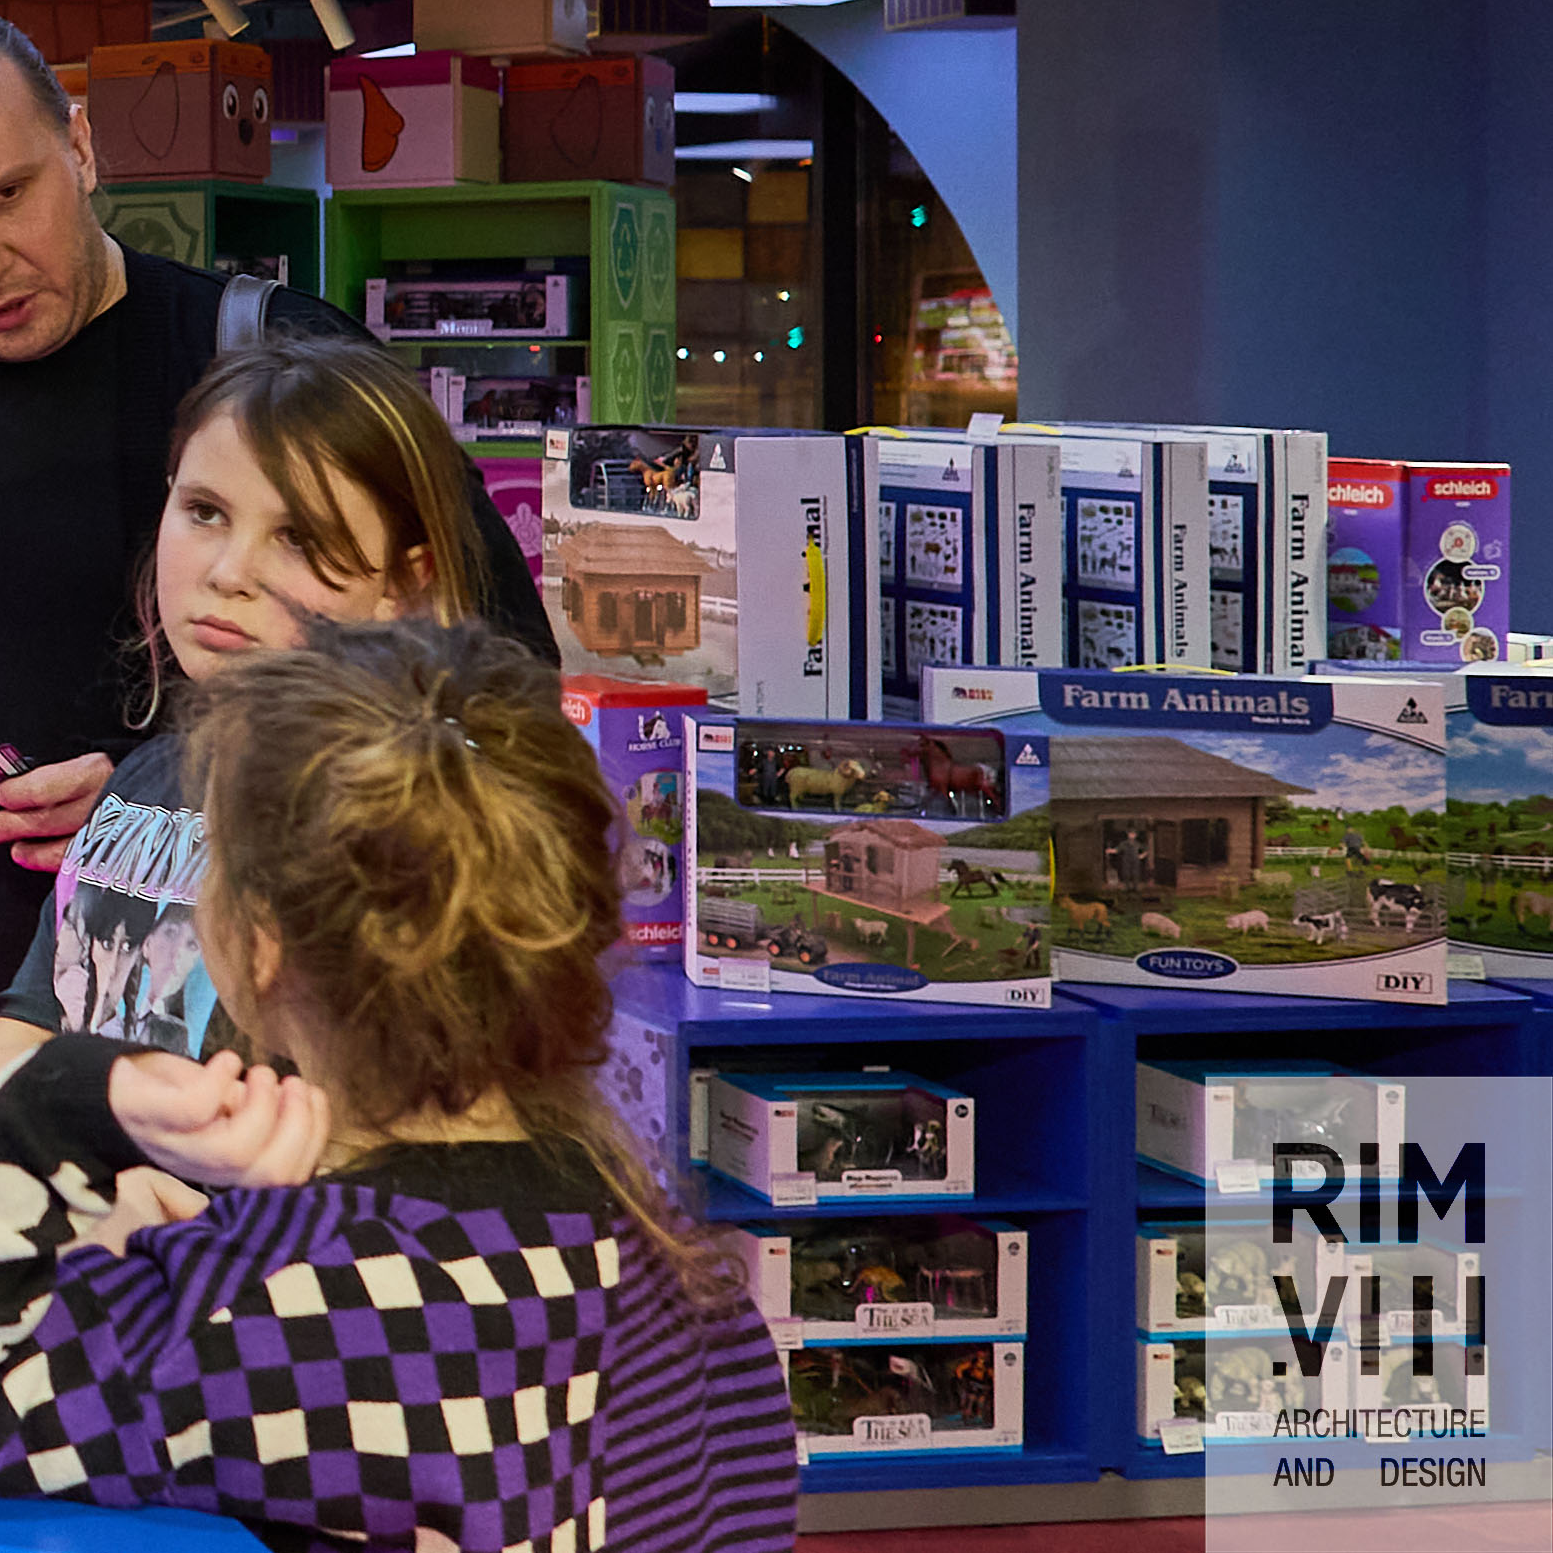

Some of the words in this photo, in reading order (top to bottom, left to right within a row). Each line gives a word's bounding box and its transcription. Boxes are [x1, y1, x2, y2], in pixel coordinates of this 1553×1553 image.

[1327, 484, 1384, 504] chleich
[1433, 480, 1491, 496] schleich
[1018, 503, 1036, 564] Farm
[1290, 493, 1310, 560] Farm
[1173, 524, 1187, 572] Farm
[1173, 578, 1188, 658] Animals
[1062, 684, 1150, 710] Farm
[1162, 687, 1310, 716] Animals
[1149, 955, 1182, 970] FUN
[1183, 957, 1225, 973] TOYS
[1010, 989, 1039, 1003] DIY
[1383, 975, 1425, 991] DIY
